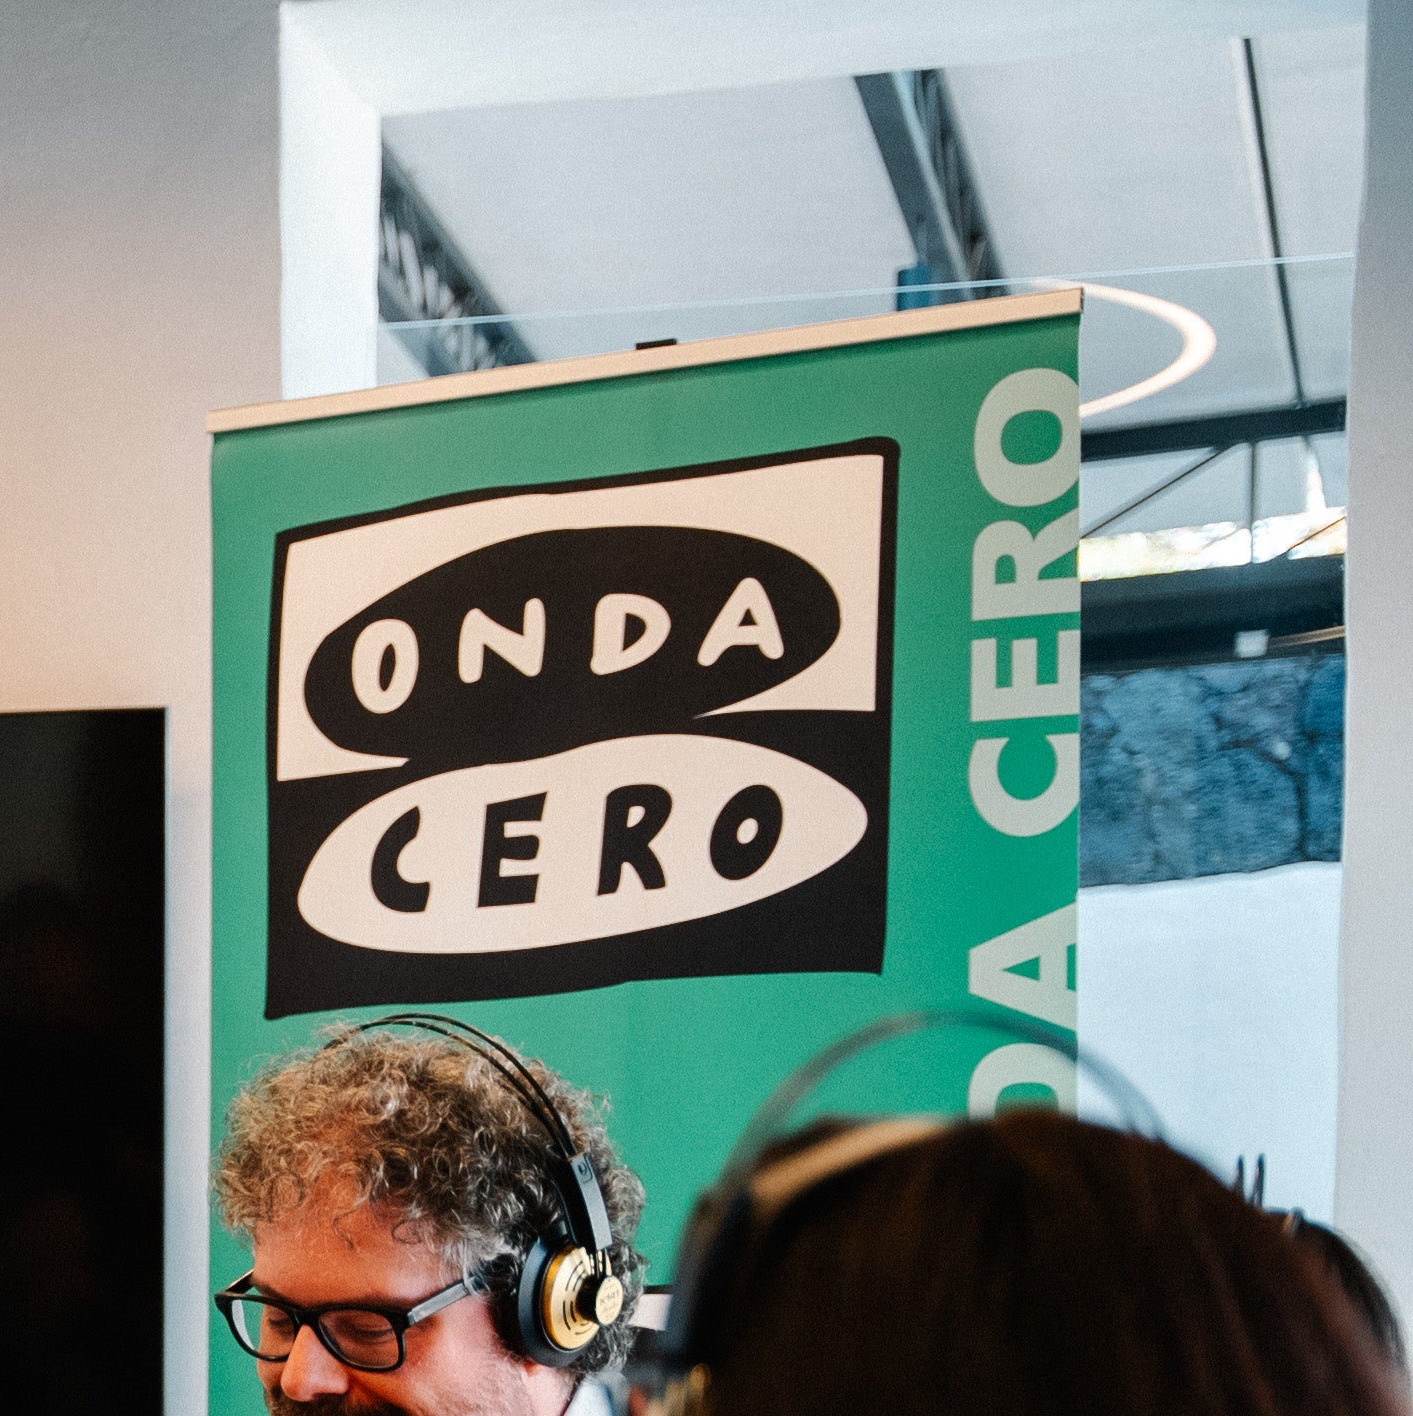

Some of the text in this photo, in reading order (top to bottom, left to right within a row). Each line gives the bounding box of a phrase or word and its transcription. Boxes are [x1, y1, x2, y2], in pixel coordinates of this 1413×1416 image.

[351, 577, 785, 714] ONDA
[968, 368, 1080, 1122] DA CERO
[370, 783, 784, 913] CERO
